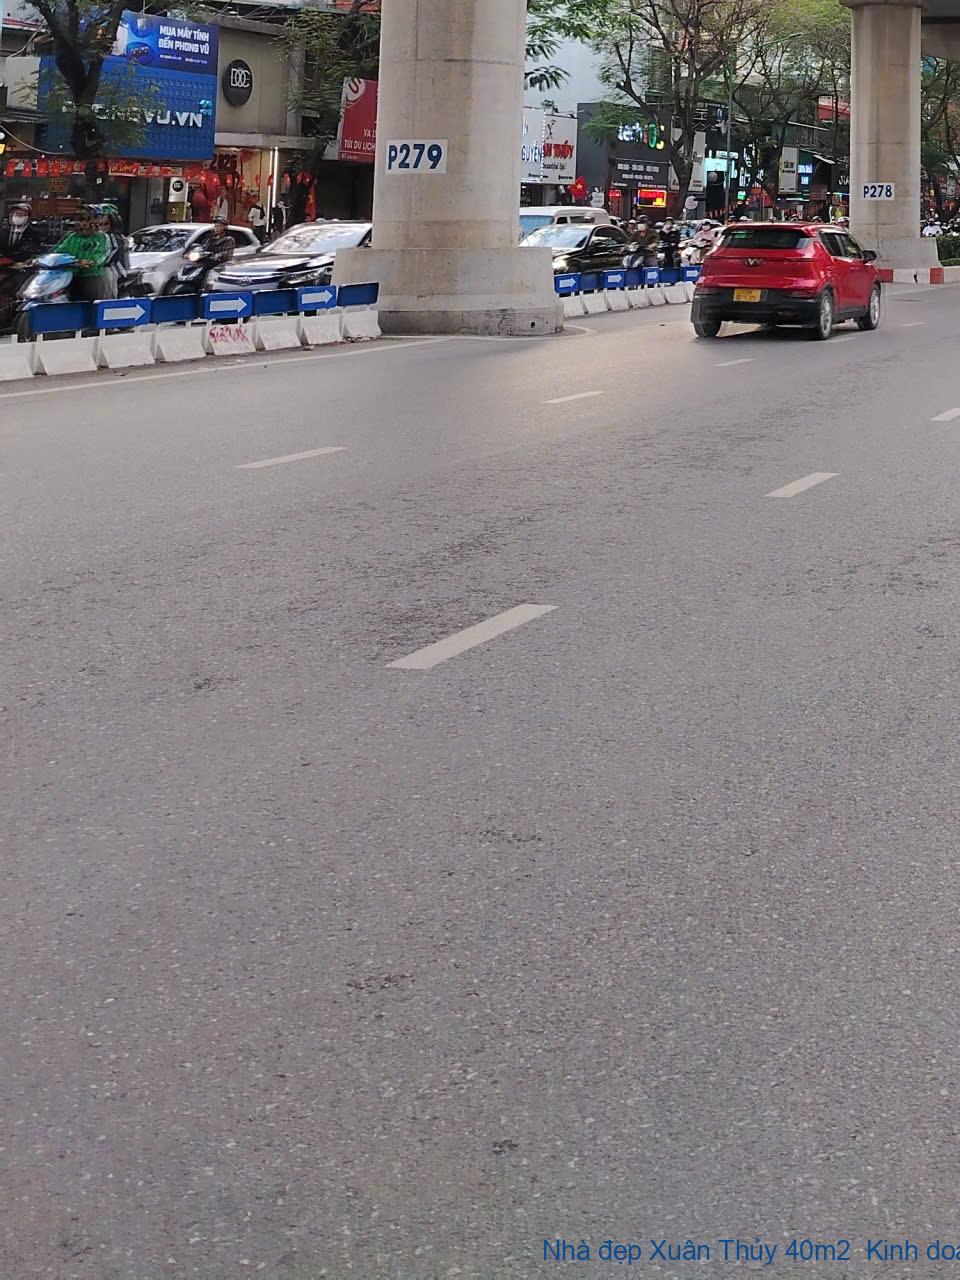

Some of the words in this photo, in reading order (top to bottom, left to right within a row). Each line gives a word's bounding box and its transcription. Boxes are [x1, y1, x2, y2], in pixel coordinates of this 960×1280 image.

[159, 25, 176, 37] MUA
[177, 27, 193, 40] MÁY
[193, 29, 210, 42] TÍNH
[158, 36, 174, 49] ĐẾN
[174, 40, 199, 53] PHONG
[199, 43, 210, 55] VŨ
[387, 143, 443, 170] P279
[863, 184, 893, 199] P278
